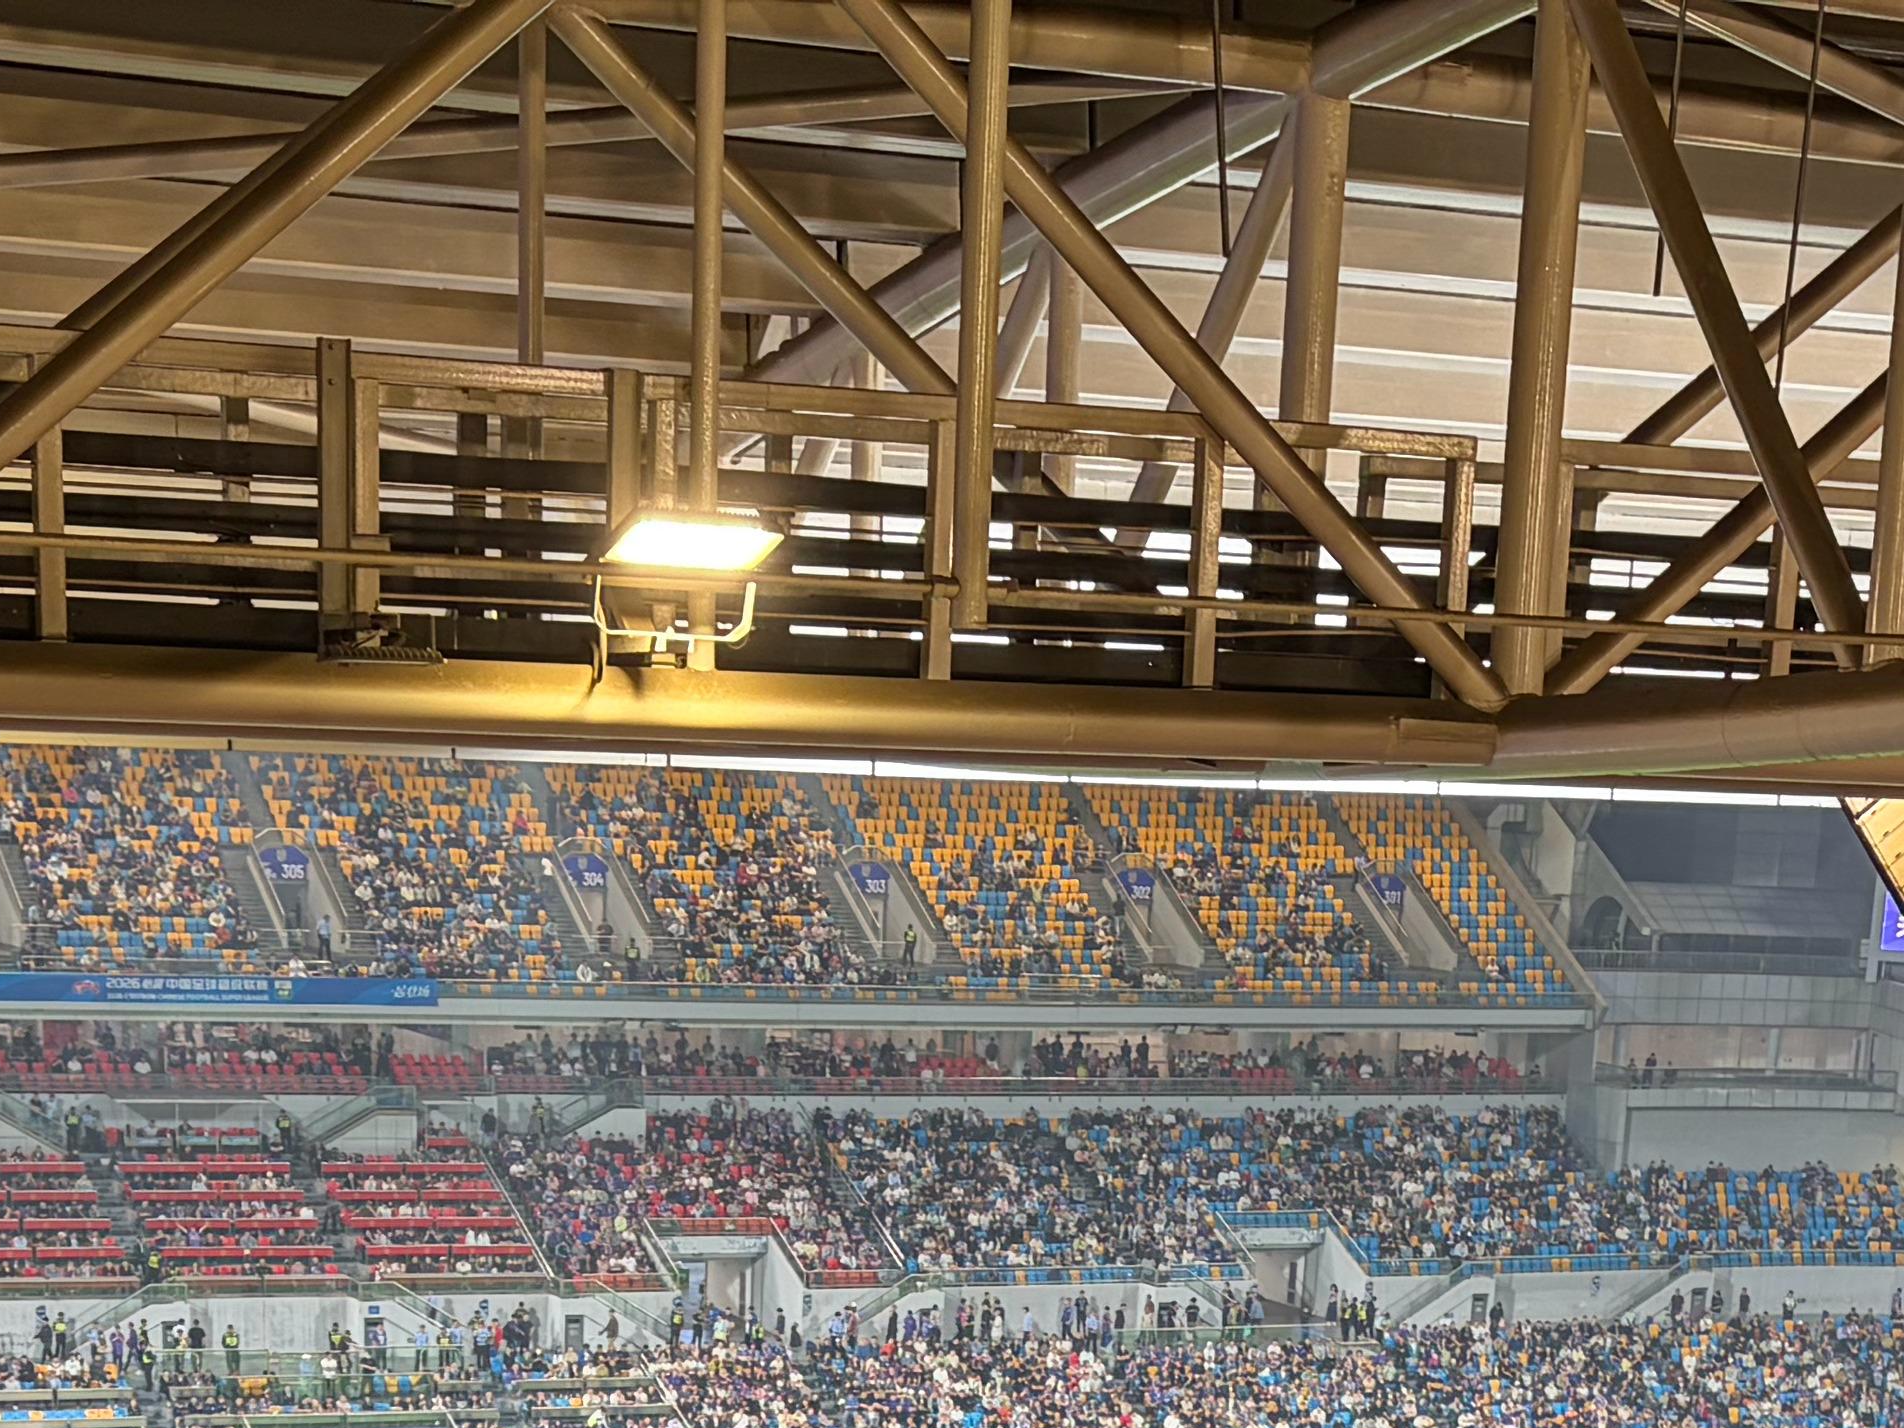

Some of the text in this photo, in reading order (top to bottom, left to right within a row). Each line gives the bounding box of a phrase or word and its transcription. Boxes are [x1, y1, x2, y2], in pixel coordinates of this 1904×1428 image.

[281, 864, 304, 879] 305
[582, 872, 604, 887] 304
[865, 879, 886, 894] 303
[1132, 885, 1152, 899] 302
